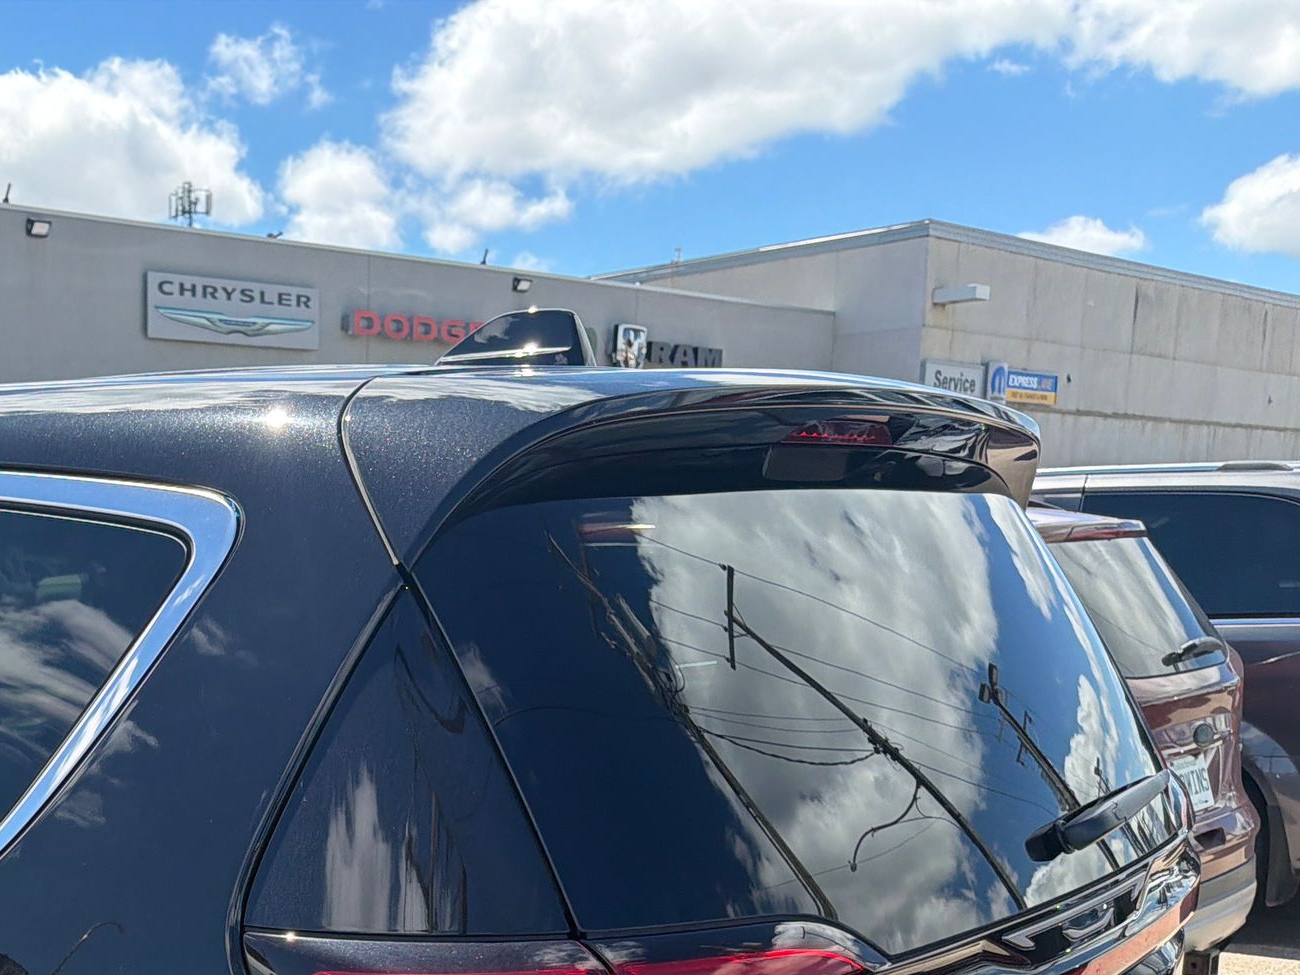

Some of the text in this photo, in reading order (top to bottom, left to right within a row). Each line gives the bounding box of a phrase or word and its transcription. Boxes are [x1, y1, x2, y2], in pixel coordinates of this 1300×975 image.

[157, 279, 312, 309] CHRYSLER
[646, 341, 724, 368] RAM
[933, 369, 976, 393] Service
